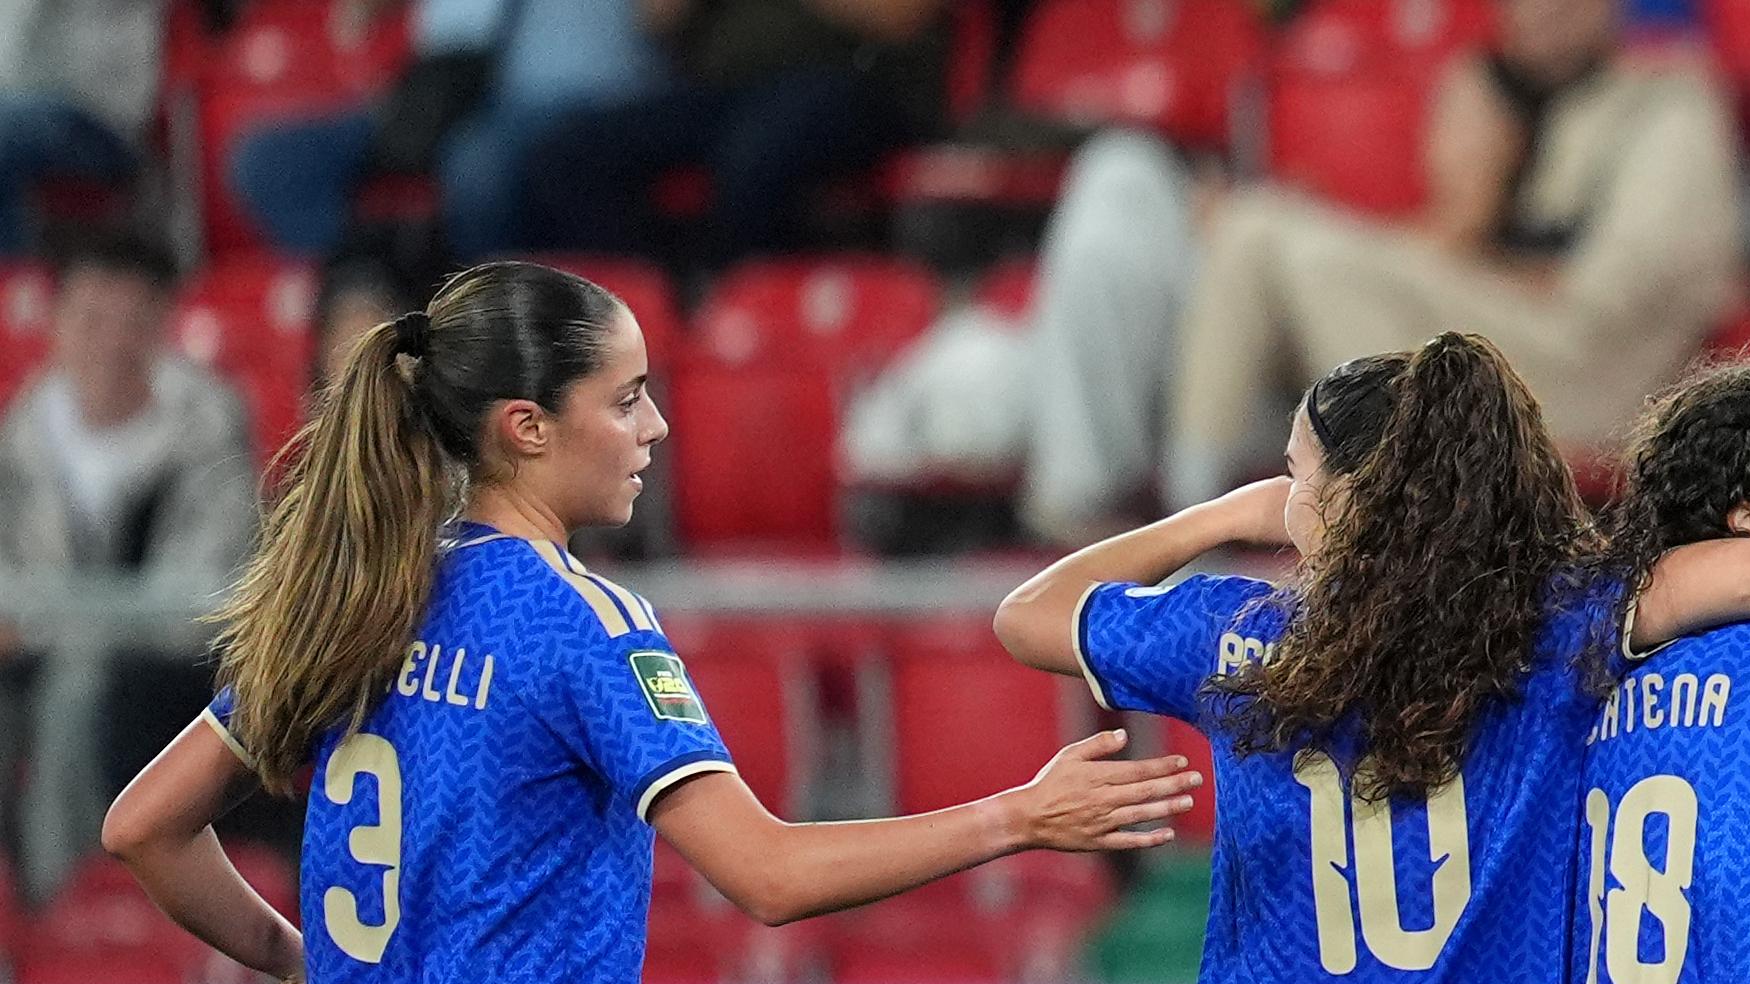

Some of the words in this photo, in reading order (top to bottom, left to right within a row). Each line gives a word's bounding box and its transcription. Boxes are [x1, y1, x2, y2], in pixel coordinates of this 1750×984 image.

[384, 640, 494, 710] ELLI
[1586, 673, 1731, 746] ATENA
[323, 733, 401, 964] 3
[1292, 748, 1472, 976] 10
